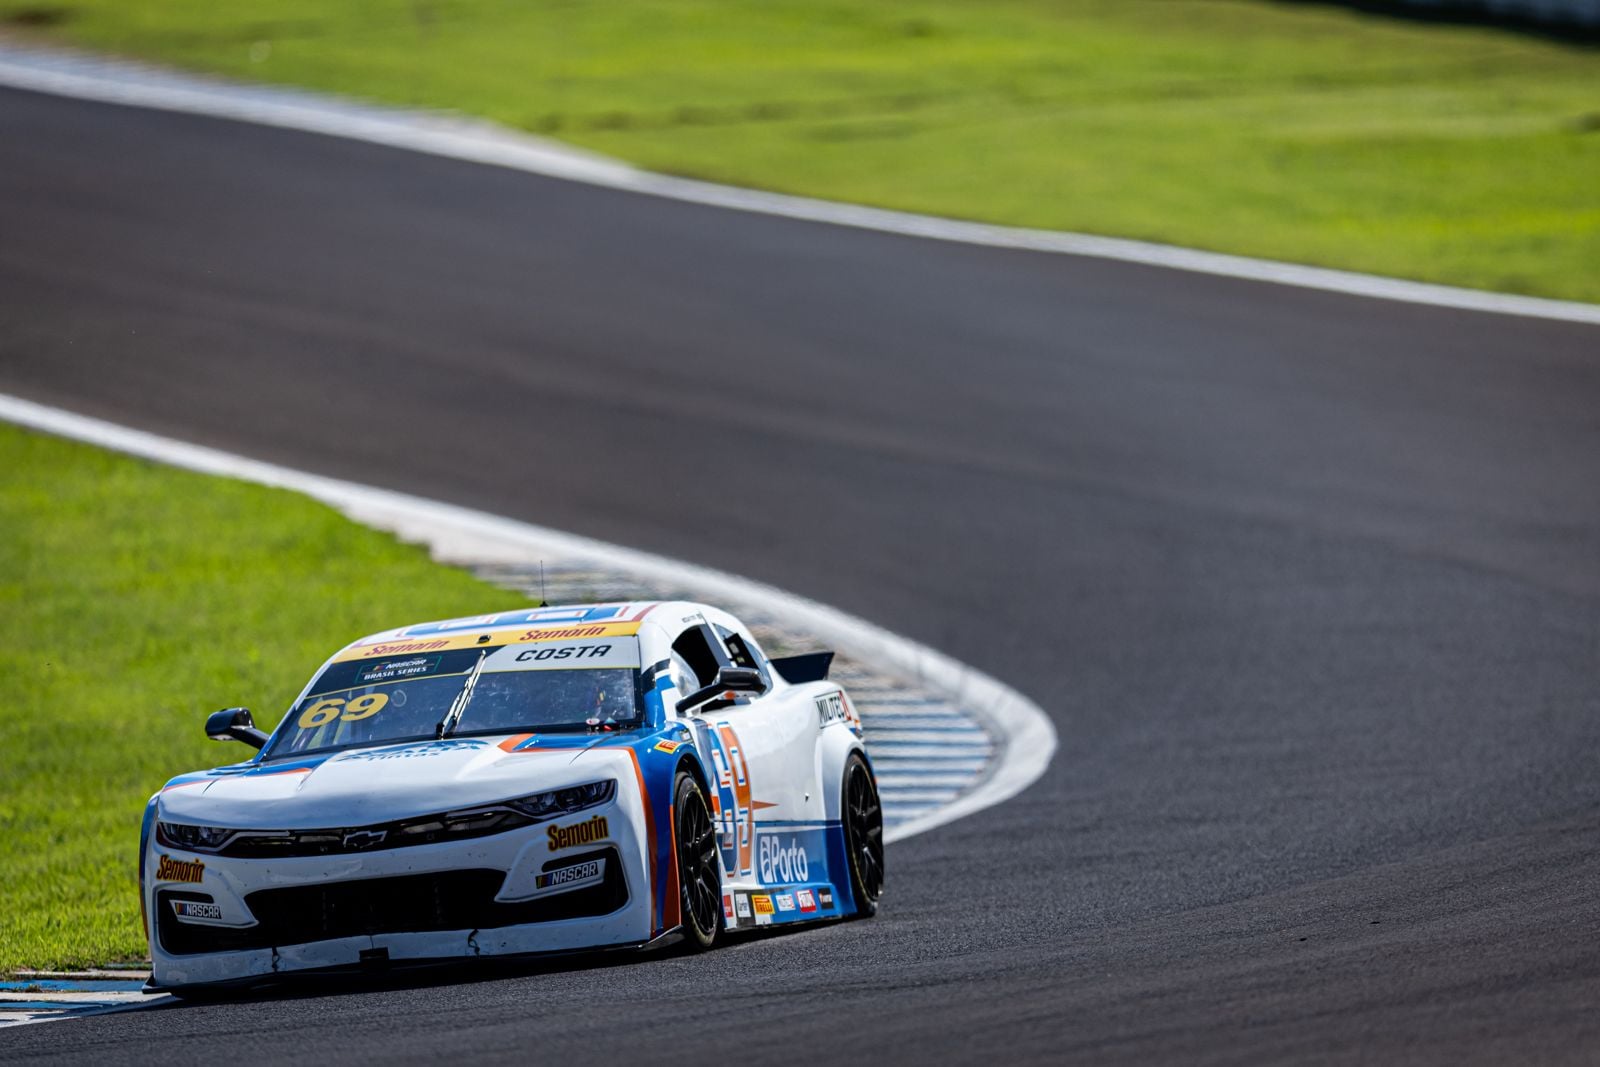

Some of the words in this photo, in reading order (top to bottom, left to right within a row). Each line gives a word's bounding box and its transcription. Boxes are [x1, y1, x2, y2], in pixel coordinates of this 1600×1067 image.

[520, 626, 606, 641] Semorin
[363, 639, 450, 656] Semorin
[515, 644, 612, 662] COSTA
[363, 671, 394, 680] BRASIL
[397, 667, 427, 676] SERIES
[298, 693, 389, 729] 69
[546, 815, 608, 852] Semorin
[157, 854, 205, 883] Semorin
[772, 836, 808, 883] Porto
[551, 861, 597, 885] NASCAR
[186, 903, 220, 918] NASCAR
